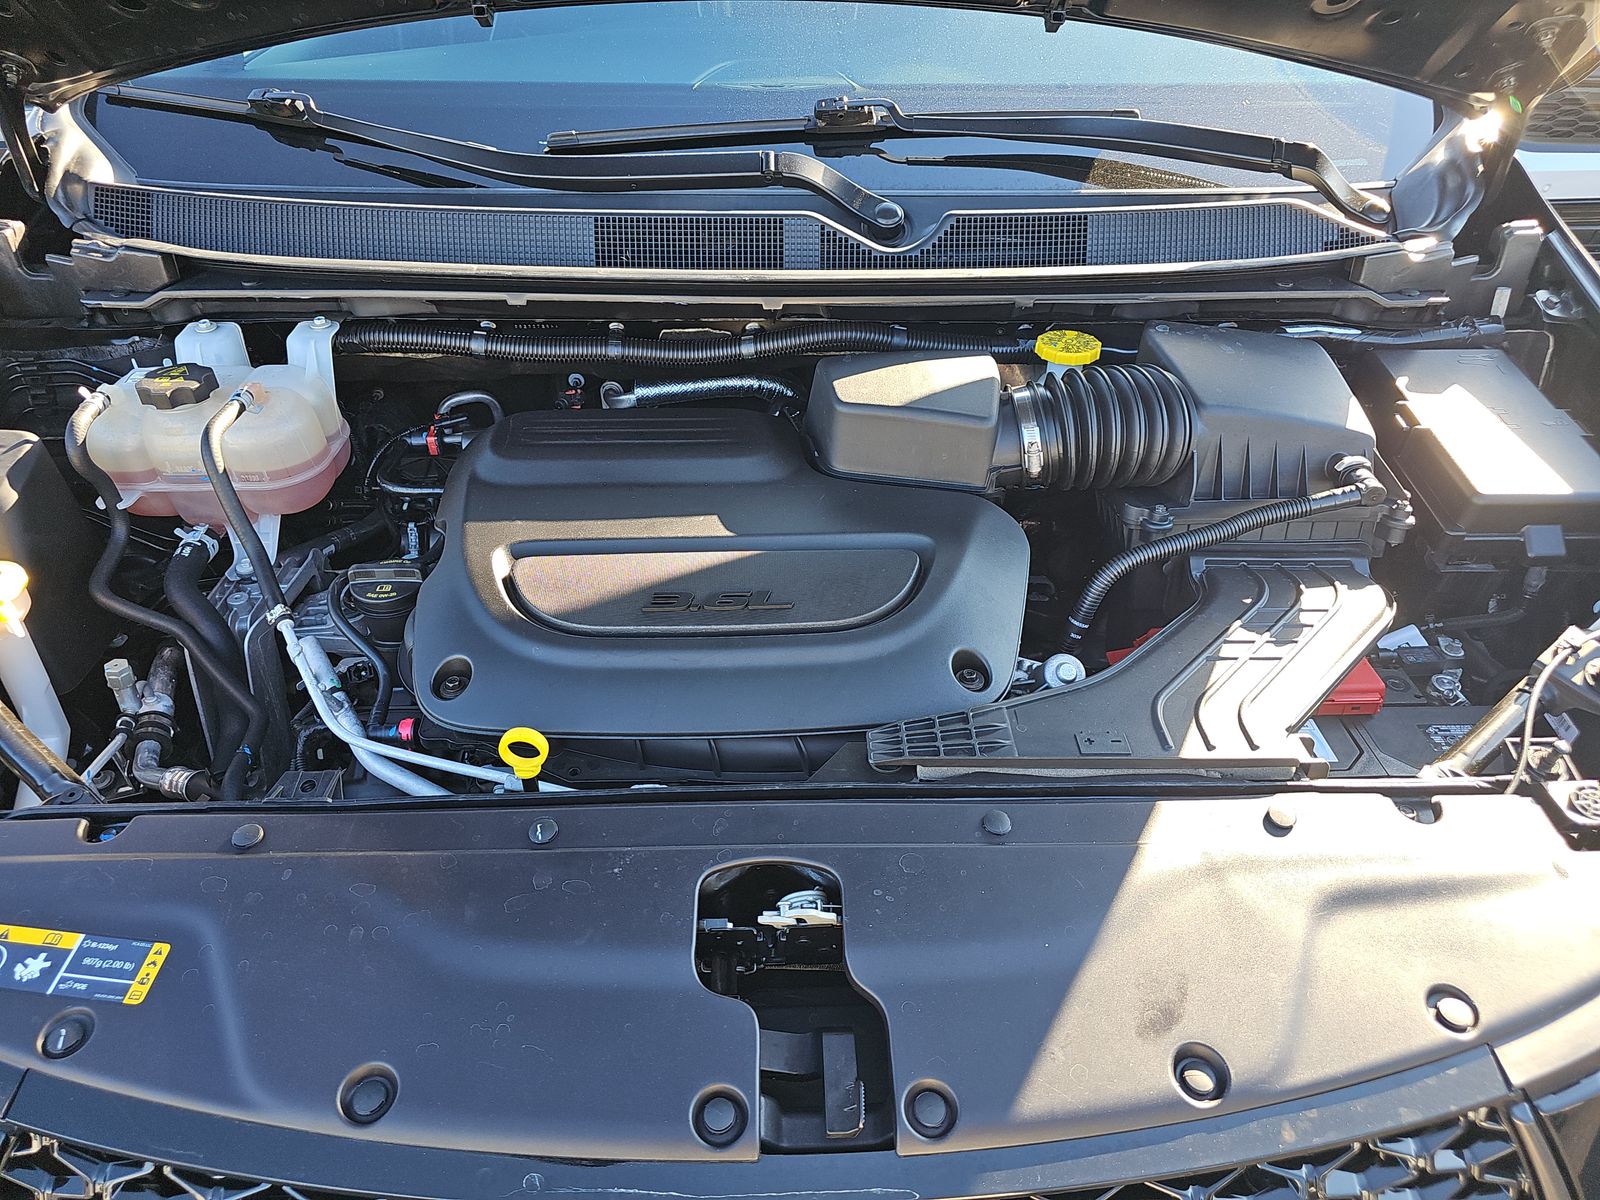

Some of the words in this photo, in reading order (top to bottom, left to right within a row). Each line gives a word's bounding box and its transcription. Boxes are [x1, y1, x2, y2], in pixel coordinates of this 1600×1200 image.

[641, 590, 795, 612] 3.6L
[81, 956, 103, 968] 907g
[102, 959, 124, 970] (2.00
[122, 961, 136, 972] lb)
